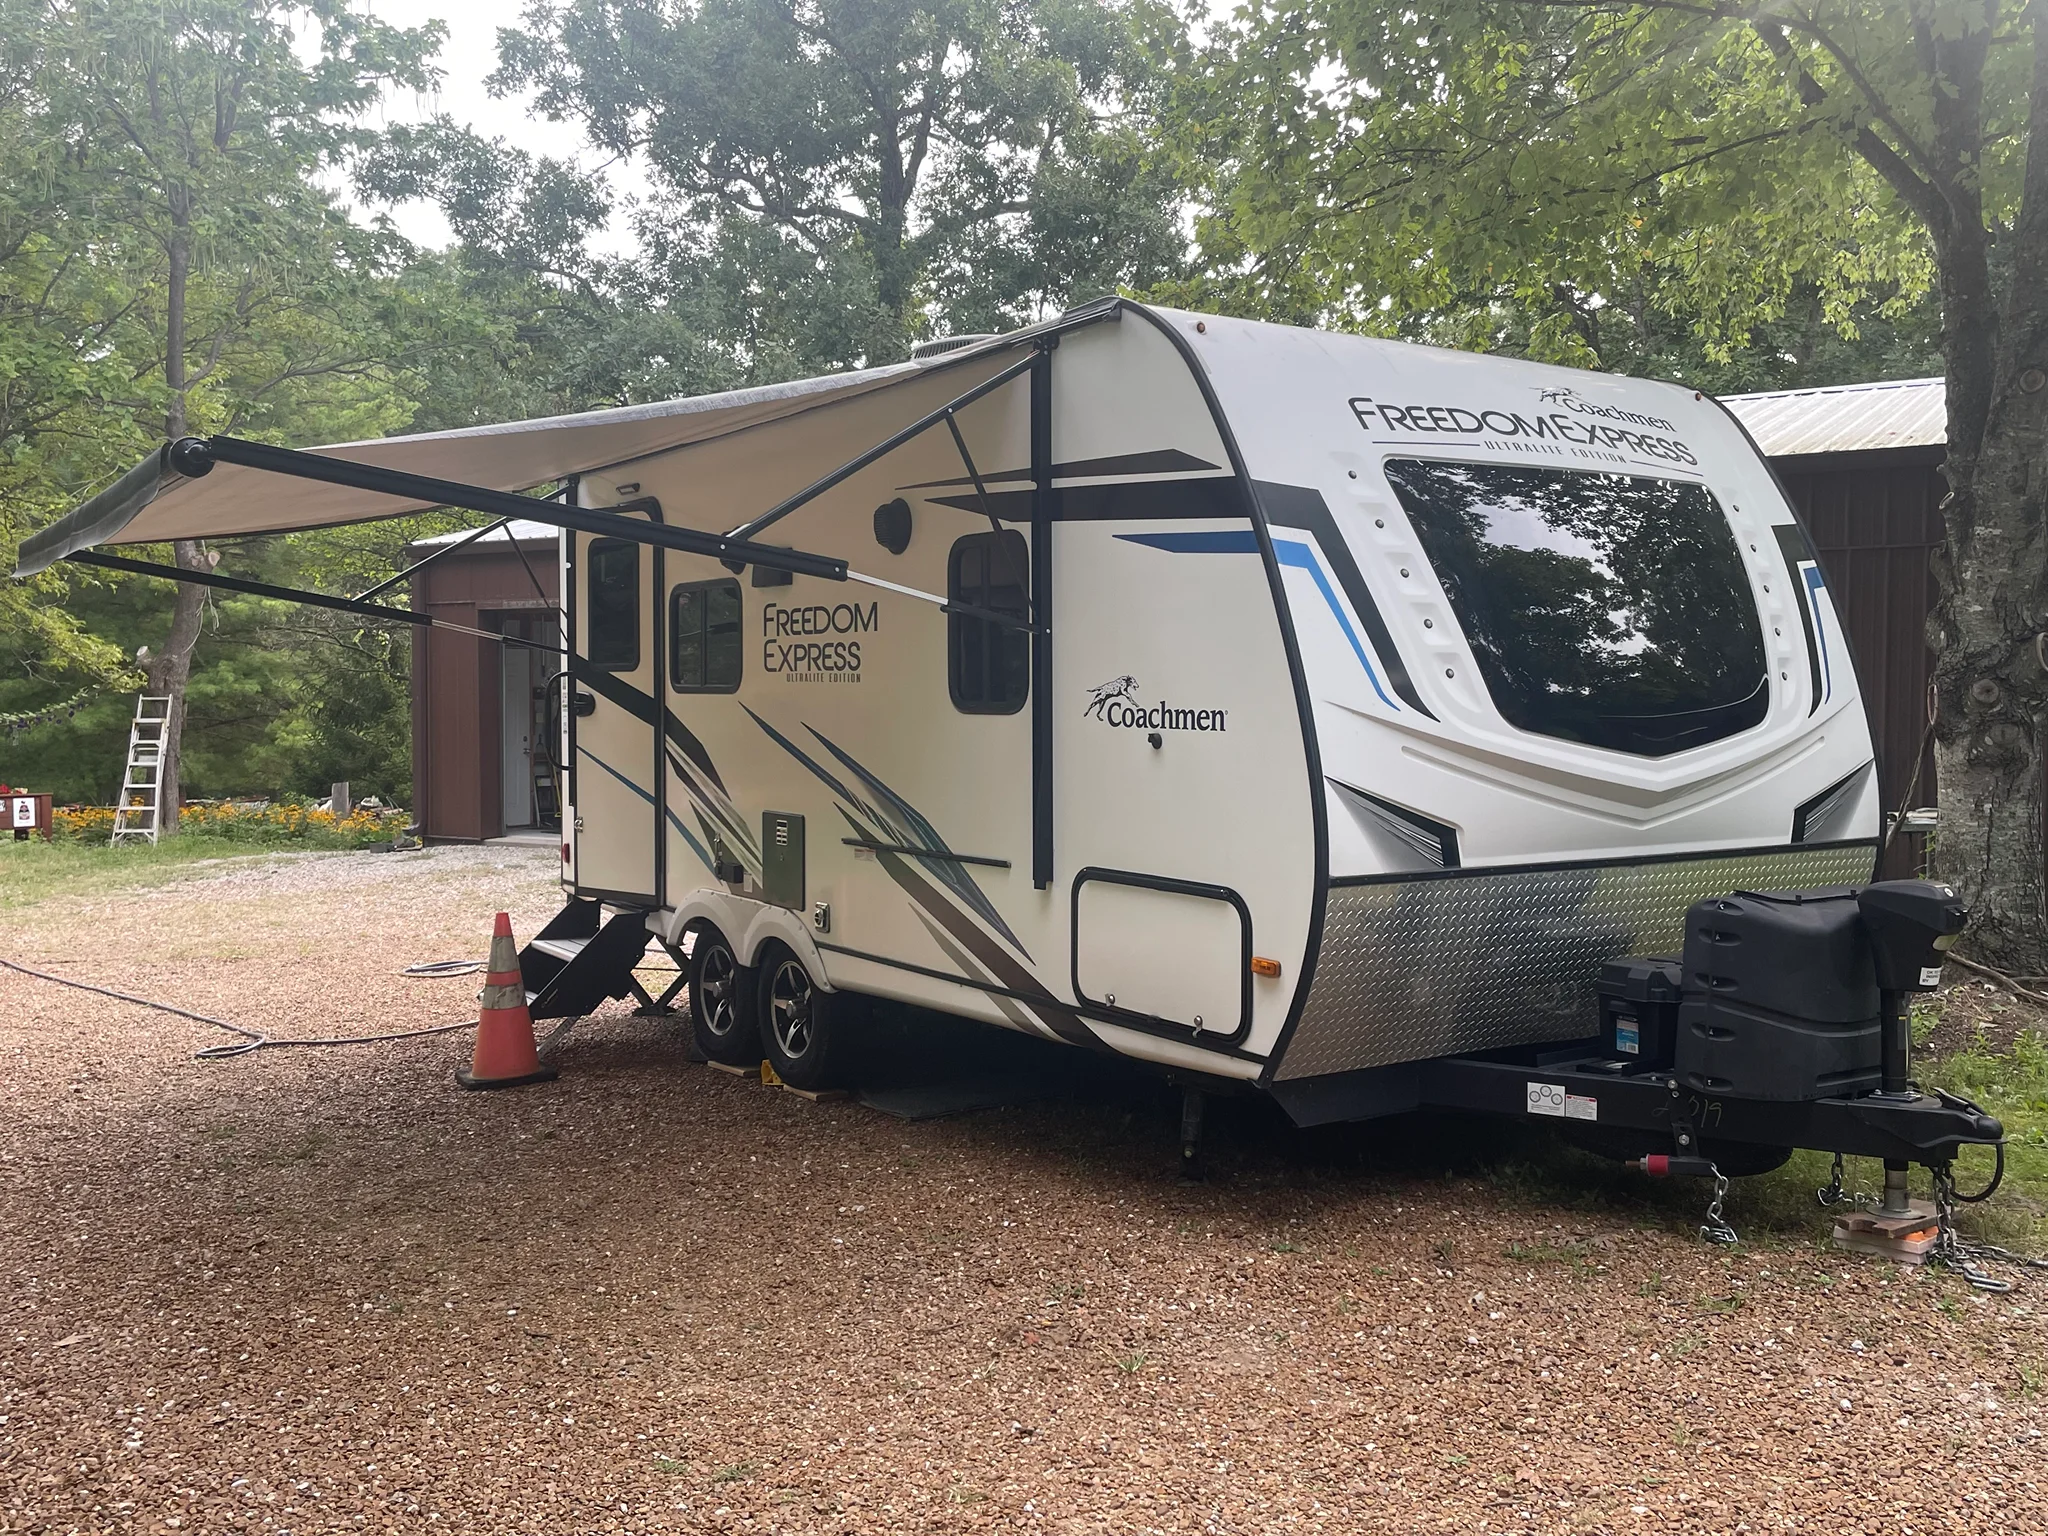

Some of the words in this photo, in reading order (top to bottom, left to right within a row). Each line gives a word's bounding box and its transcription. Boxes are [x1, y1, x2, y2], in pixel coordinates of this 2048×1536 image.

[1562, 398, 1677, 432] Coachmen
[1483, 441, 1564, 455] ULTRALITE
[1570, 448, 1627, 464] EDITION
[763, 602, 878, 637] FREEDOM
[764, 639, 861, 672] EXPRESS
[786, 673, 825, 682] ULTRALITE
[829, 672, 861, 683] EDITION
[1107, 700, 1226, 731] Coachmen
